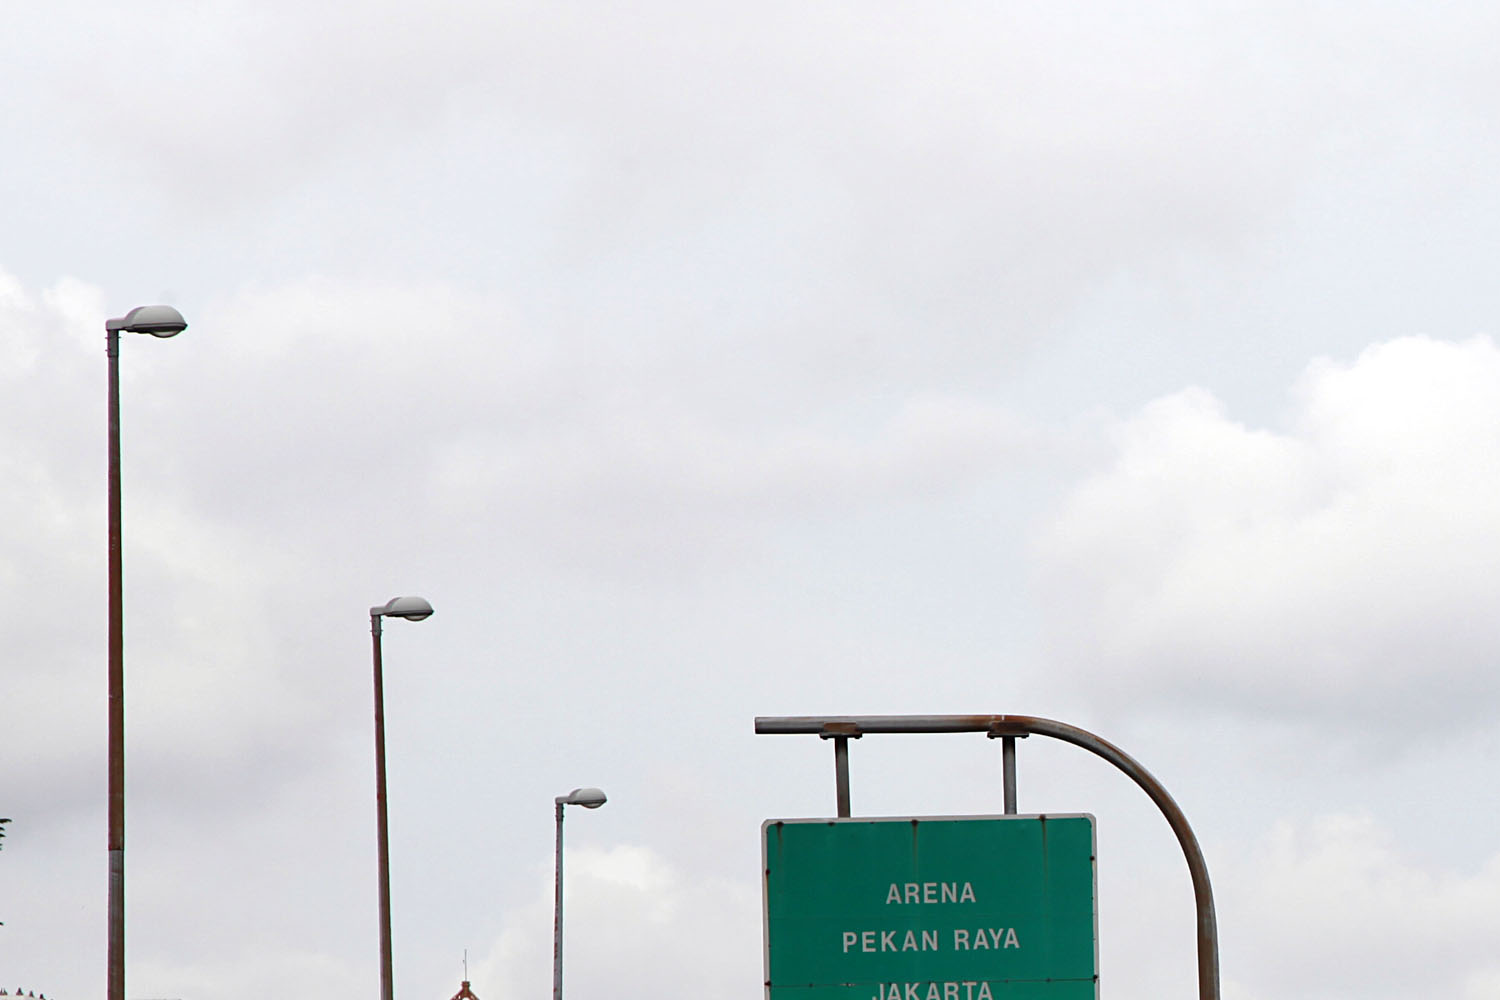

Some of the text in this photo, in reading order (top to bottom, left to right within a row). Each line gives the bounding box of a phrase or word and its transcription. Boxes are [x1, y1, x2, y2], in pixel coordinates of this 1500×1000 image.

[886, 882, 976, 904] ARENA
[843, 928, 1020, 953] PEKAN RAYA
